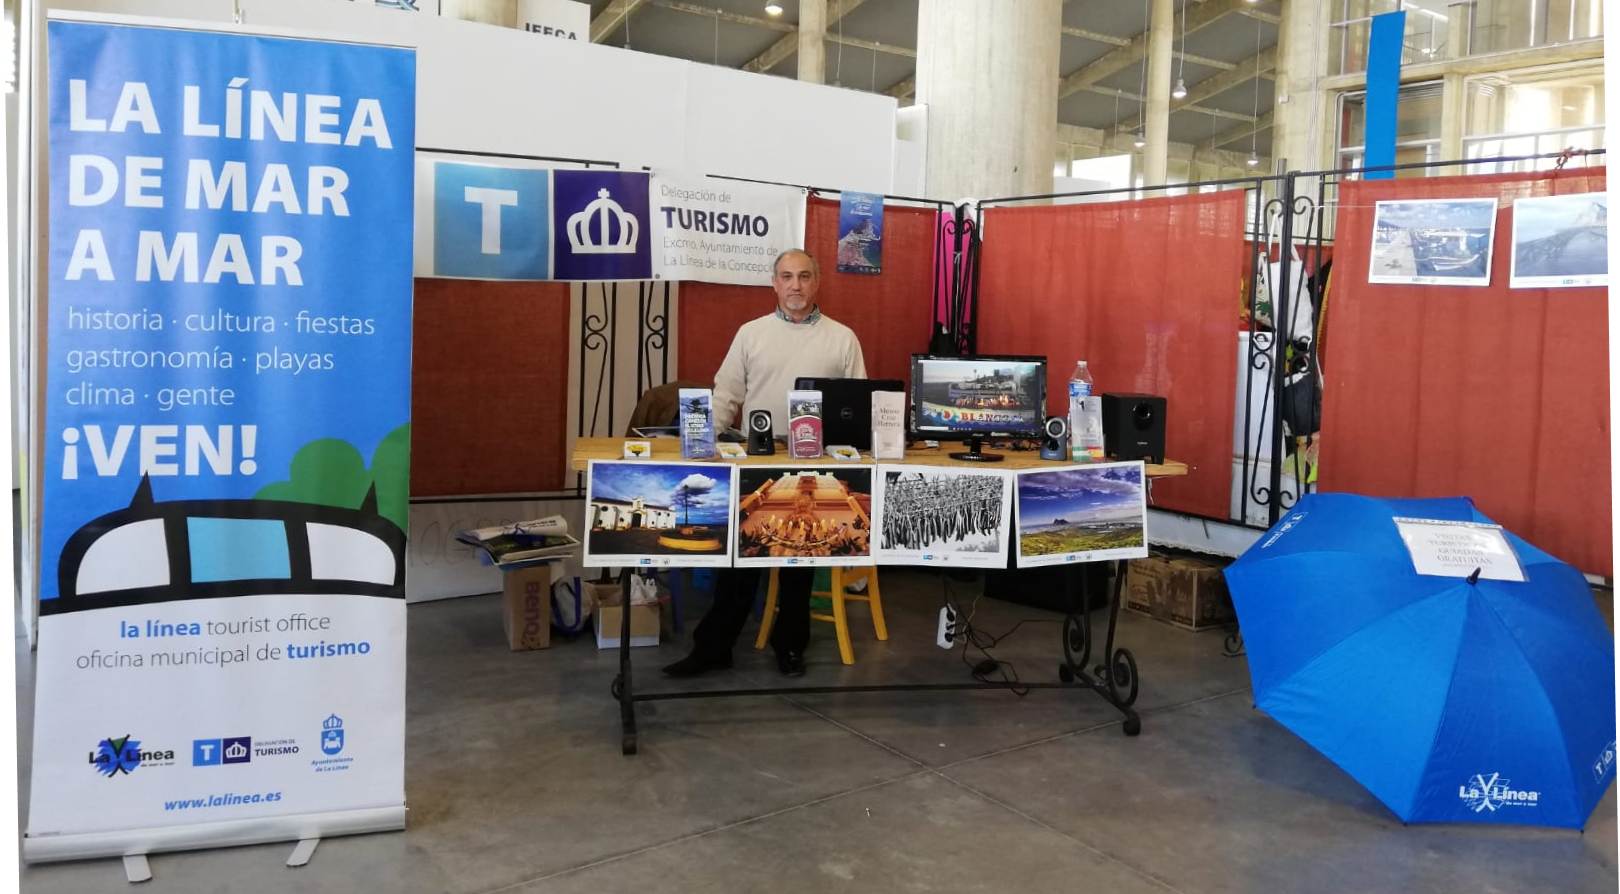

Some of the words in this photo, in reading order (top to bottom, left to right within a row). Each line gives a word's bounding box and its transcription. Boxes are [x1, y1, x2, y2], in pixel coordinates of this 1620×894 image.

[69, 79, 161, 134] LA
[183, 77, 393, 149] LÍNEA
[69, 154, 164, 208] DE
[184, 159, 350, 217] MAR
[661, 184, 716, 202] Delegación
[718, 191, 732, 203] de
[464, 186, 519, 255] T
[660, 206, 769, 238] TURISMO
[64, 229, 116, 281] A
[135, 230, 304, 286] MAR
[663, 254, 677, 266] La
[705, 257, 716, 269] de
[700, 240, 764, 256] Ayuntamiento
[766, 245, 778, 256] de
[68, 306, 163, 331] historia
[184, 307, 275, 333] cultura
[296, 310, 375, 335] fiestas
[66, 345, 233, 373] gastronomía
[255, 346, 335, 375] playas
[65, 381, 135, 406] clima
[157, 384, 235, 411] gente
[61, 424, 259, 480] ¡VEN!
[120, 621, 140, 638] la
[146, 619, 201, 638] línea
[207, 617, 271, 636] tourist
[276, 613, 331, 632] office
[76, 649, 144, 669] oficina
[151, 644, 250, 668] municipal
[256, 643, 282, 661] de
[287, 639, 371, 659] turismo
[89, 751, 111, 764] La
[200, 744, 215, 761] T
[255, 746, 300, 756] TURISMO
[164, 790, 282, 811] www.lalinea.es
[1459, 785, 1479, 799] La
[1493, 786, 1538, 801] Línea
